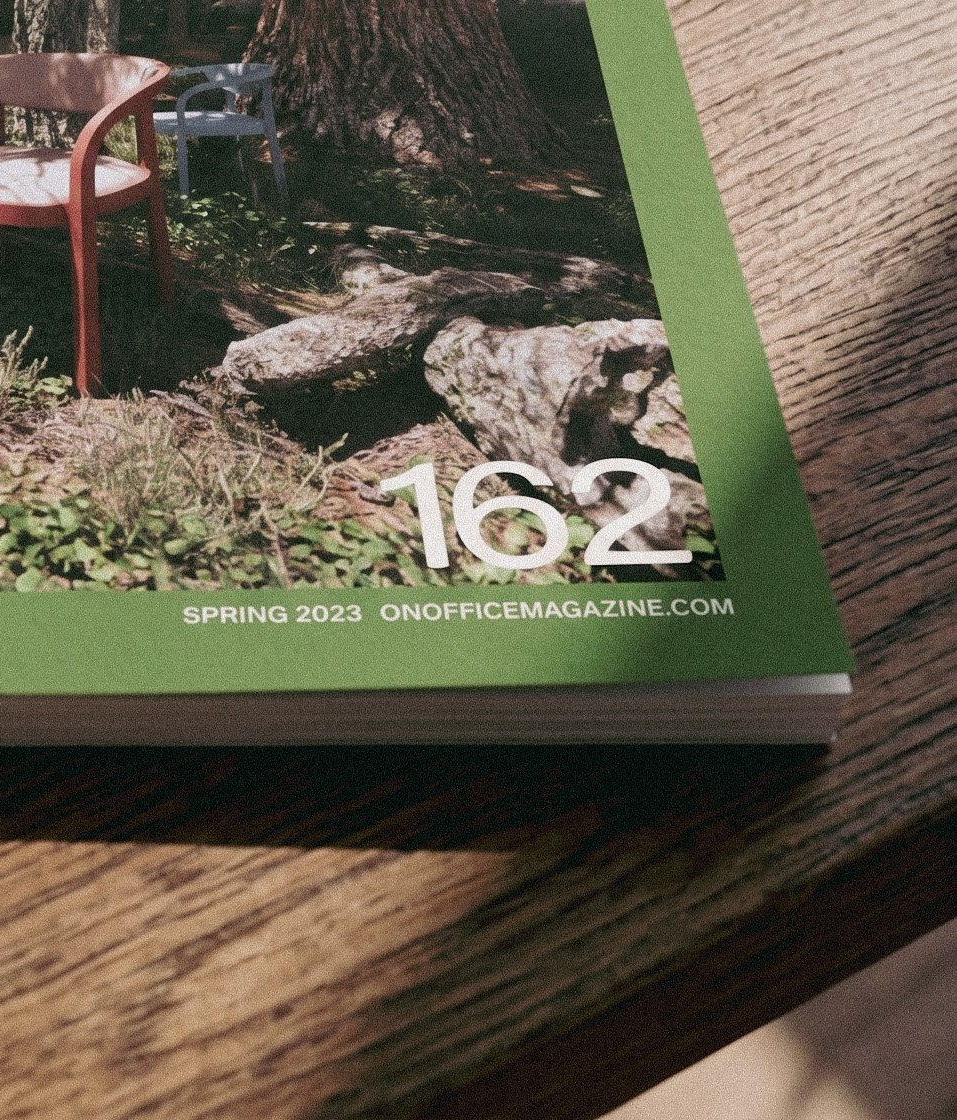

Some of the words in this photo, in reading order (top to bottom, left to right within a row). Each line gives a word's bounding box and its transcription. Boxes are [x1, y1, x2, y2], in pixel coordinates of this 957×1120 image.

[380, 458, 693, 570] 162
[183, 605, 288, 625] SPRING
[295, 603, 362, 624] 2023
[380, 597, 735, 622] ONOFFICEMAGAZINE.COM
